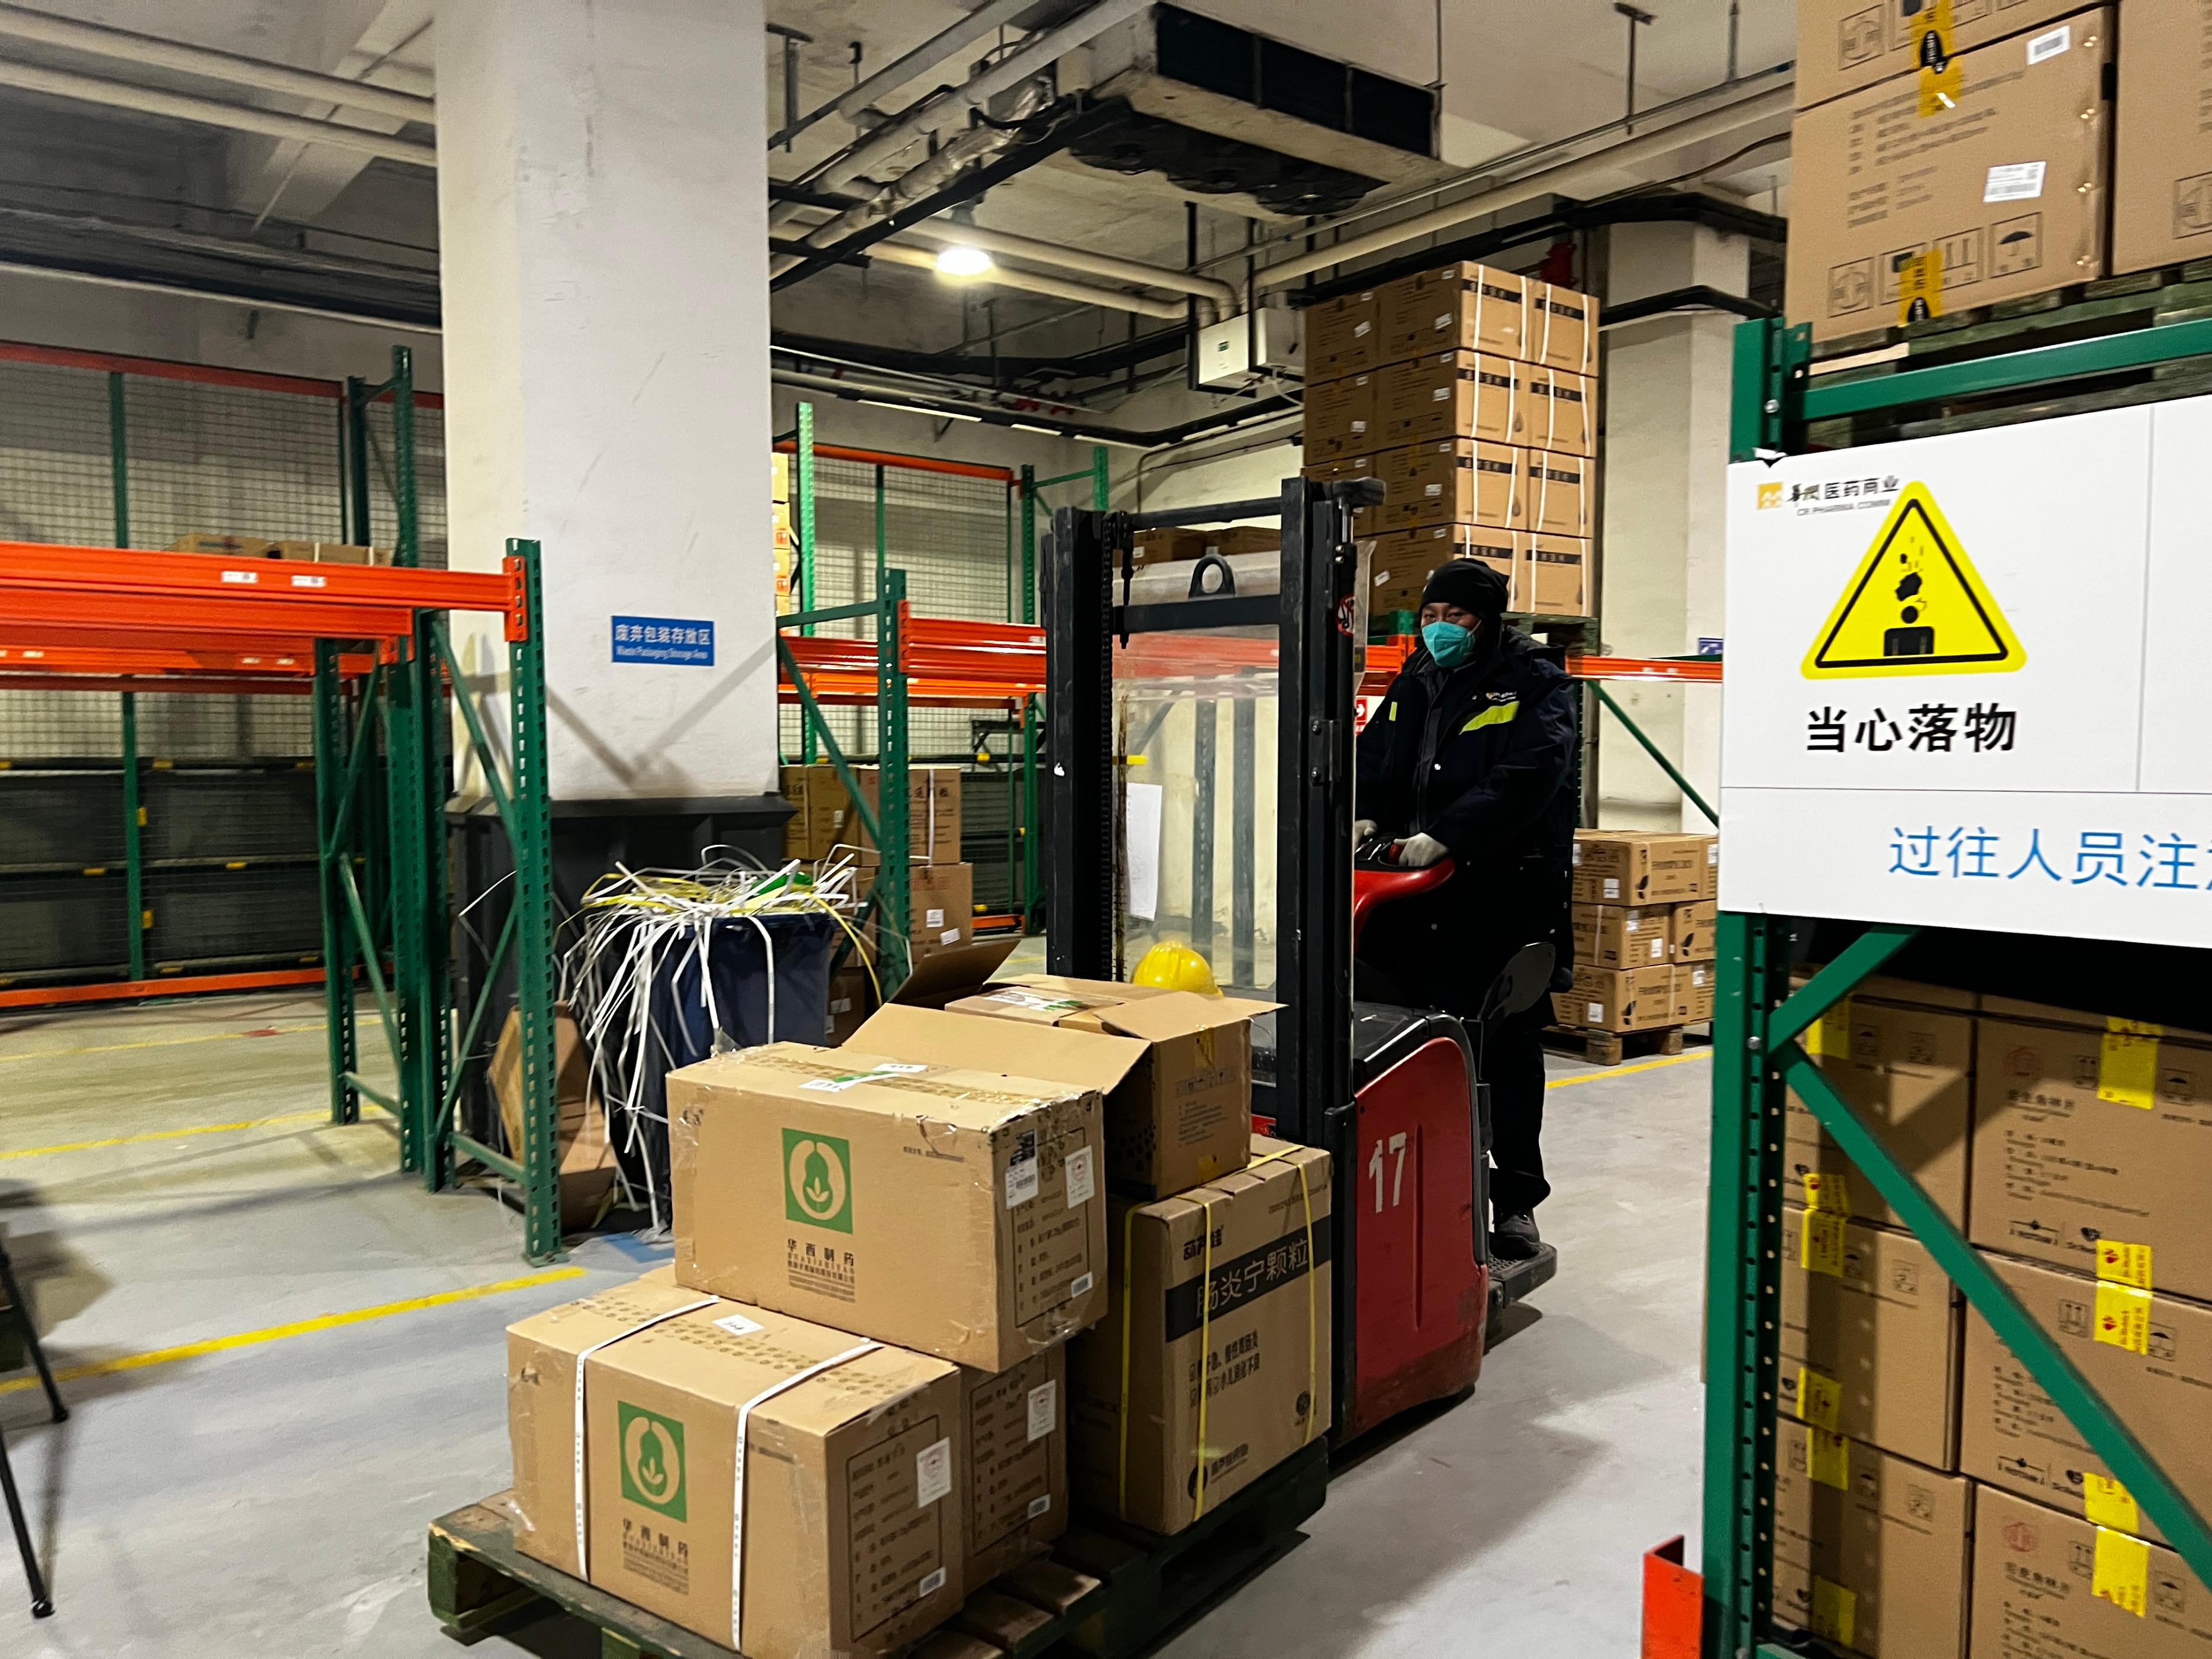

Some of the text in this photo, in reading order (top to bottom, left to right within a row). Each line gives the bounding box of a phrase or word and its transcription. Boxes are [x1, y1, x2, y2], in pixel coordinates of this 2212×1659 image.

[1806, 703, 2017, 753] 当心落物
[1889, 825, 2212, 891] 过往人员注
[1369, 1132, 1407, 1214] 17
[1196, 1238, 1308, 1319] 肠炎宁颗粒
